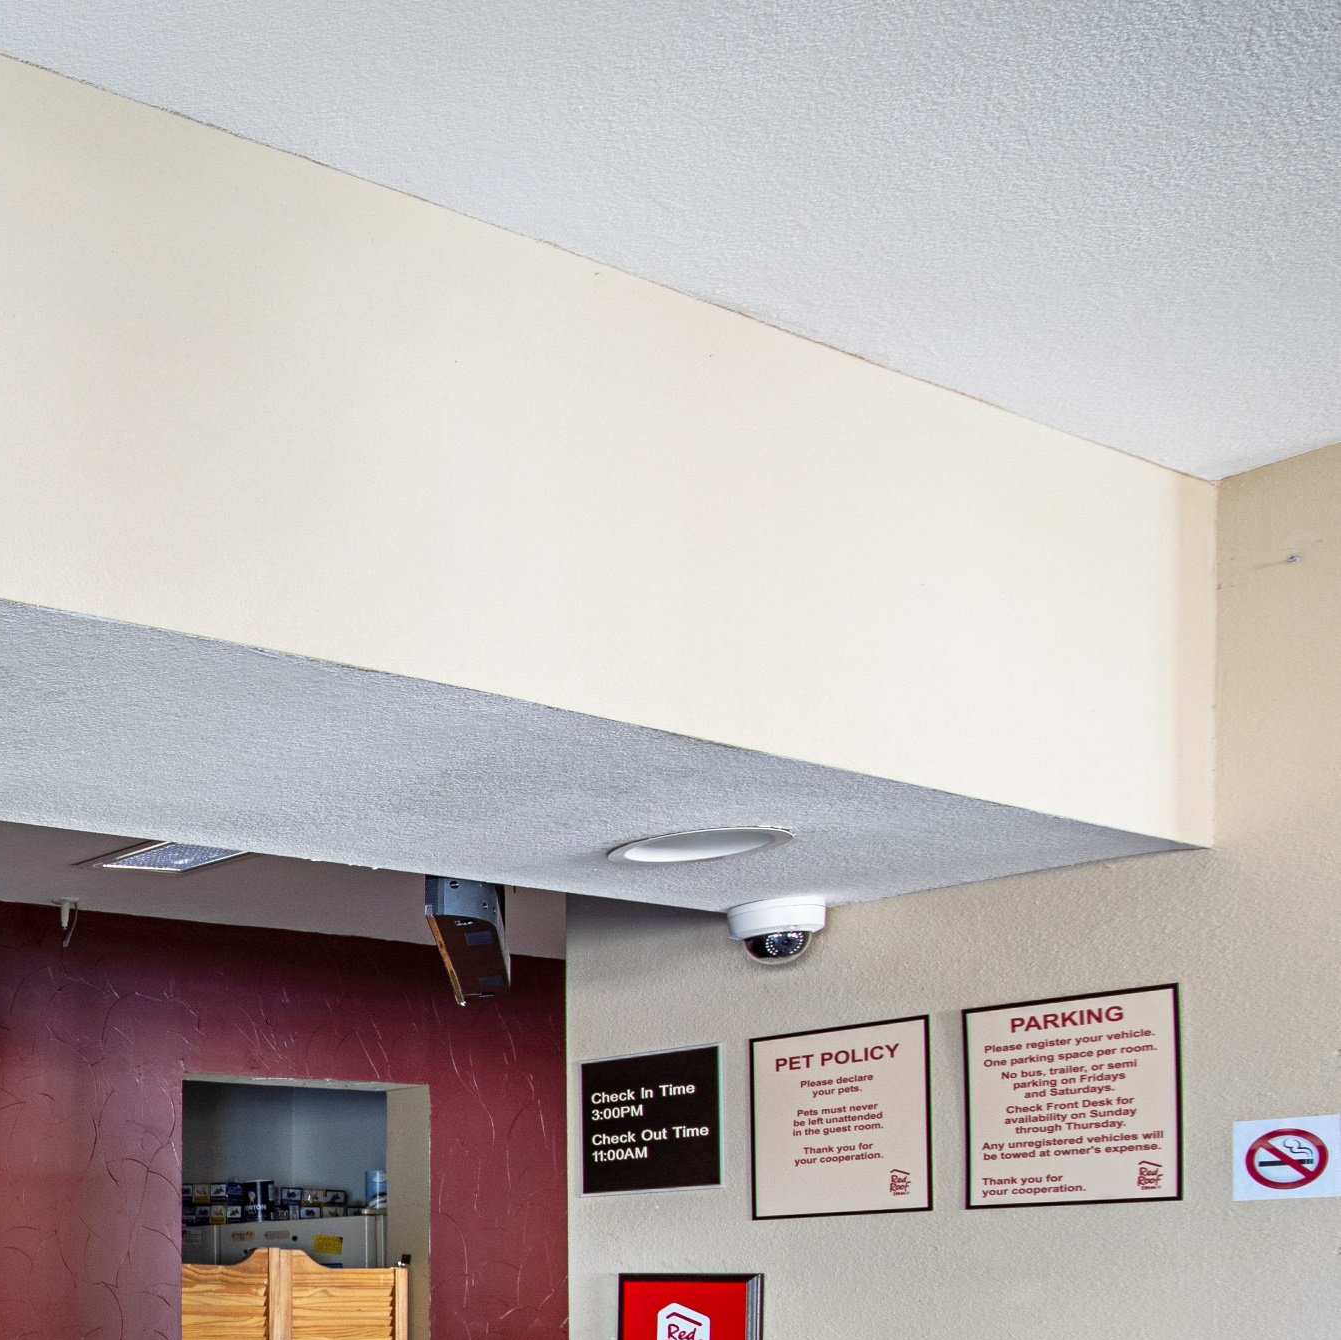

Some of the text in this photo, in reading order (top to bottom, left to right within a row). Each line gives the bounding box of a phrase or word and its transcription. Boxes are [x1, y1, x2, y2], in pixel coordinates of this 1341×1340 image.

[1010, 1006, 1124, 1033] PARKING
[984, 1029, 1155, 1053] Please register your vehicle.
[775, 1044, 899, 1072] PET POLICY
[984, 1044, 1157, 1067] One parking space per room.
[1001, 1071, 1017, 1080] No
[1021, 1068, 1045, 1078] bus,
[1049, 1065, 1087, 1075] trailer,
[1108, 1059, 1137, 1070] semi
[801, 1074, 873, 1088] Please declare
[1013, 1077, 1057, 1091] parking
[1080, 1072, 1126, 1083] Fridays
[591, 1084, 696, 1104] Check In Time
[812, 1086, 862, 1098] your pets.
[1024, 1084, 1115, 1099] and Saturdays.
[591, 1104, 644, 1121] 3:00PM
[797, 1103, 878, 1117] Pets must never
[1006, 1096, 1135, 1114] Check Front Desk for
[794, 1112, 883, 1127] be left unattended
[1005, 1107, 1136, 1125] availability on Sunday
[804, 1127, 820, 1135] the
[823, 1125, 851, 1135] guest
[854, 1122, 884, 1131] room.
[1015, 1119, 1126, 1134] through Thursday.
[591, 1126, 709, 1146] Check Out Time
[982, 1130, 1164, 1151] Any unregistered vehicles will
[591, 1146, 648, 1162] 11:00AM
[803, 1142, 873, 1154] Thank you for
[984, 1142, 1161, 1160] be towed at owner's expense.
[794, 1152, 884, 1167] your cooperation.
[891, 1175, 907, 1183] Red
[1140, 1167, 1159, 1176] Red
[890, 1181, 911, 1192] Roof
[982, 1174, 1063, 1186] Thank you for
[1137, 1175, 1163, 1186] Roof
[982, 1184, 1086, 1197] your cooperation.
[668, 1324, 696, 1340] Red
